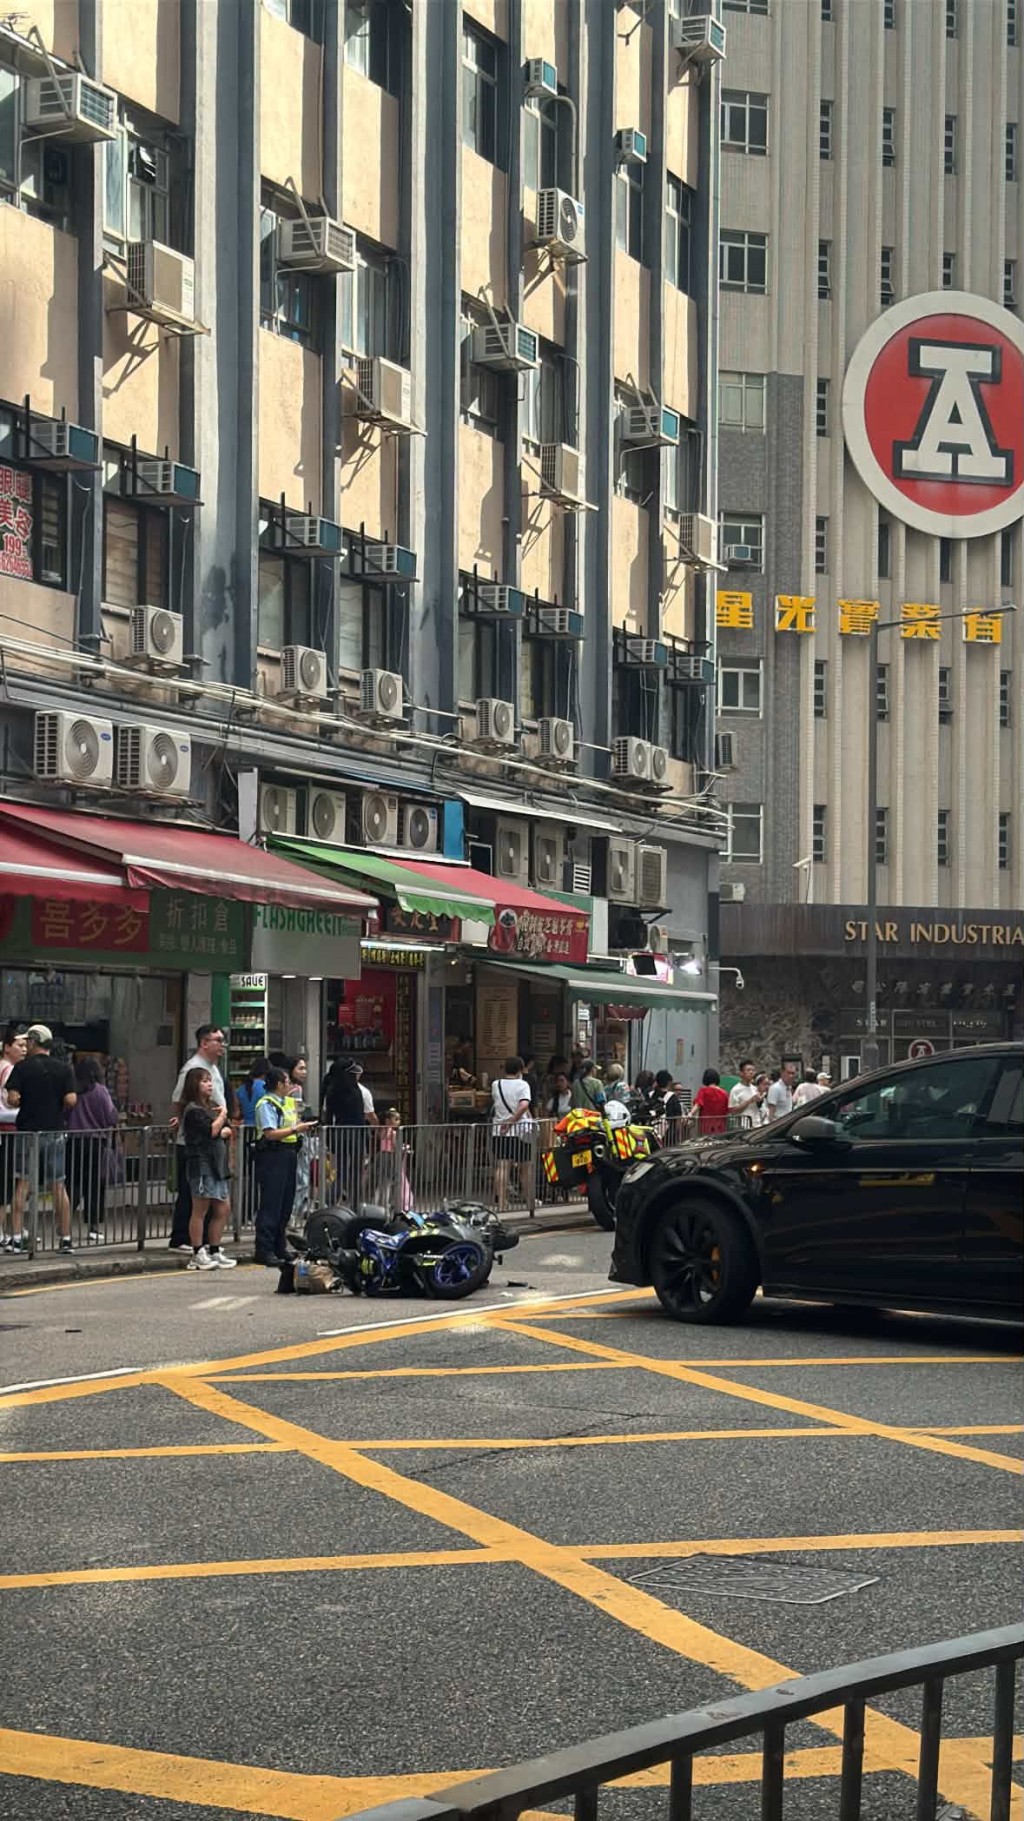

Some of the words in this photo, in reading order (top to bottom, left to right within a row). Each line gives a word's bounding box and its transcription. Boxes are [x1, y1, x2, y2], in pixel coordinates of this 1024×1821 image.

[4, 535, 21, 556] 199
[40, 899, 142, 945] 喜多多
[845, 921, 898, 942] STAR
